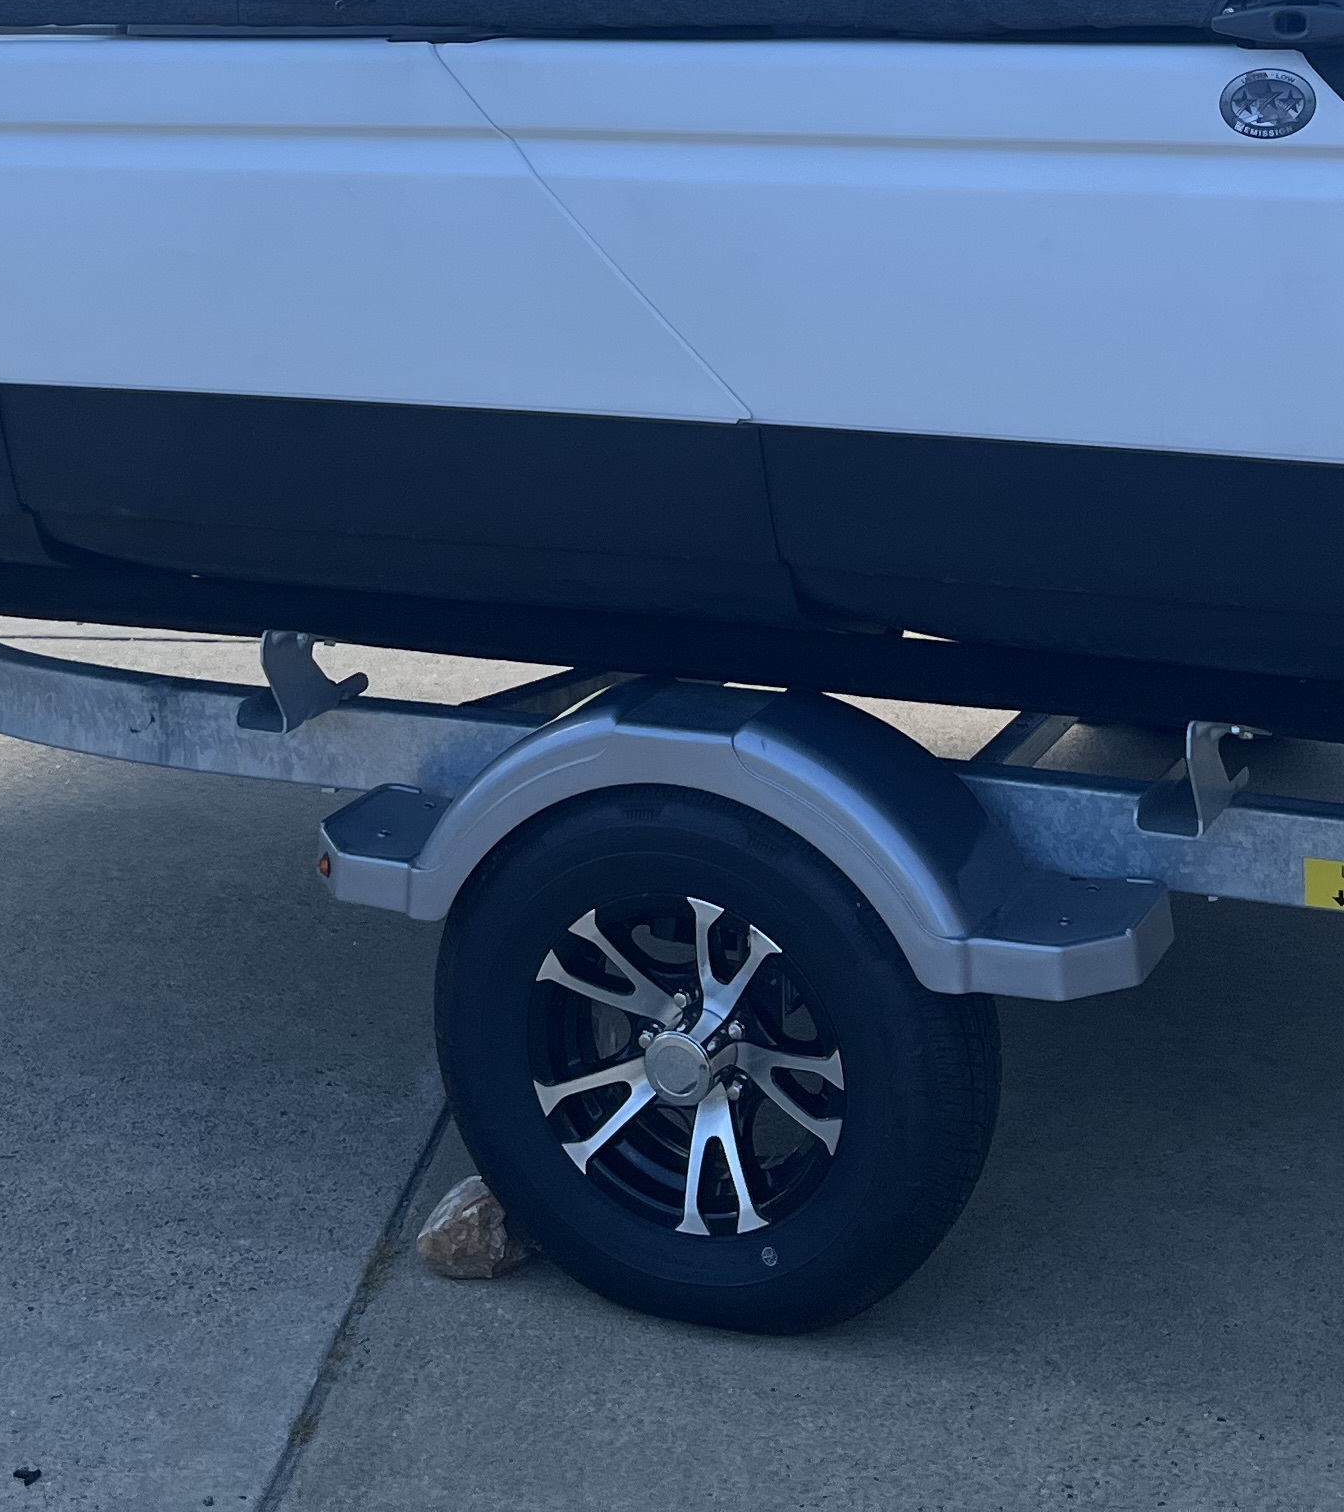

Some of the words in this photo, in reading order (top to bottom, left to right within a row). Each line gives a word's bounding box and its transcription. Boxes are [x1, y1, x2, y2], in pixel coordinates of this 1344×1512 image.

[1241, 72, 1269, 83] UTRA
[1276, 73, 1296, 83] LOW
[1244, 126, 1293, 137] EMISSION
